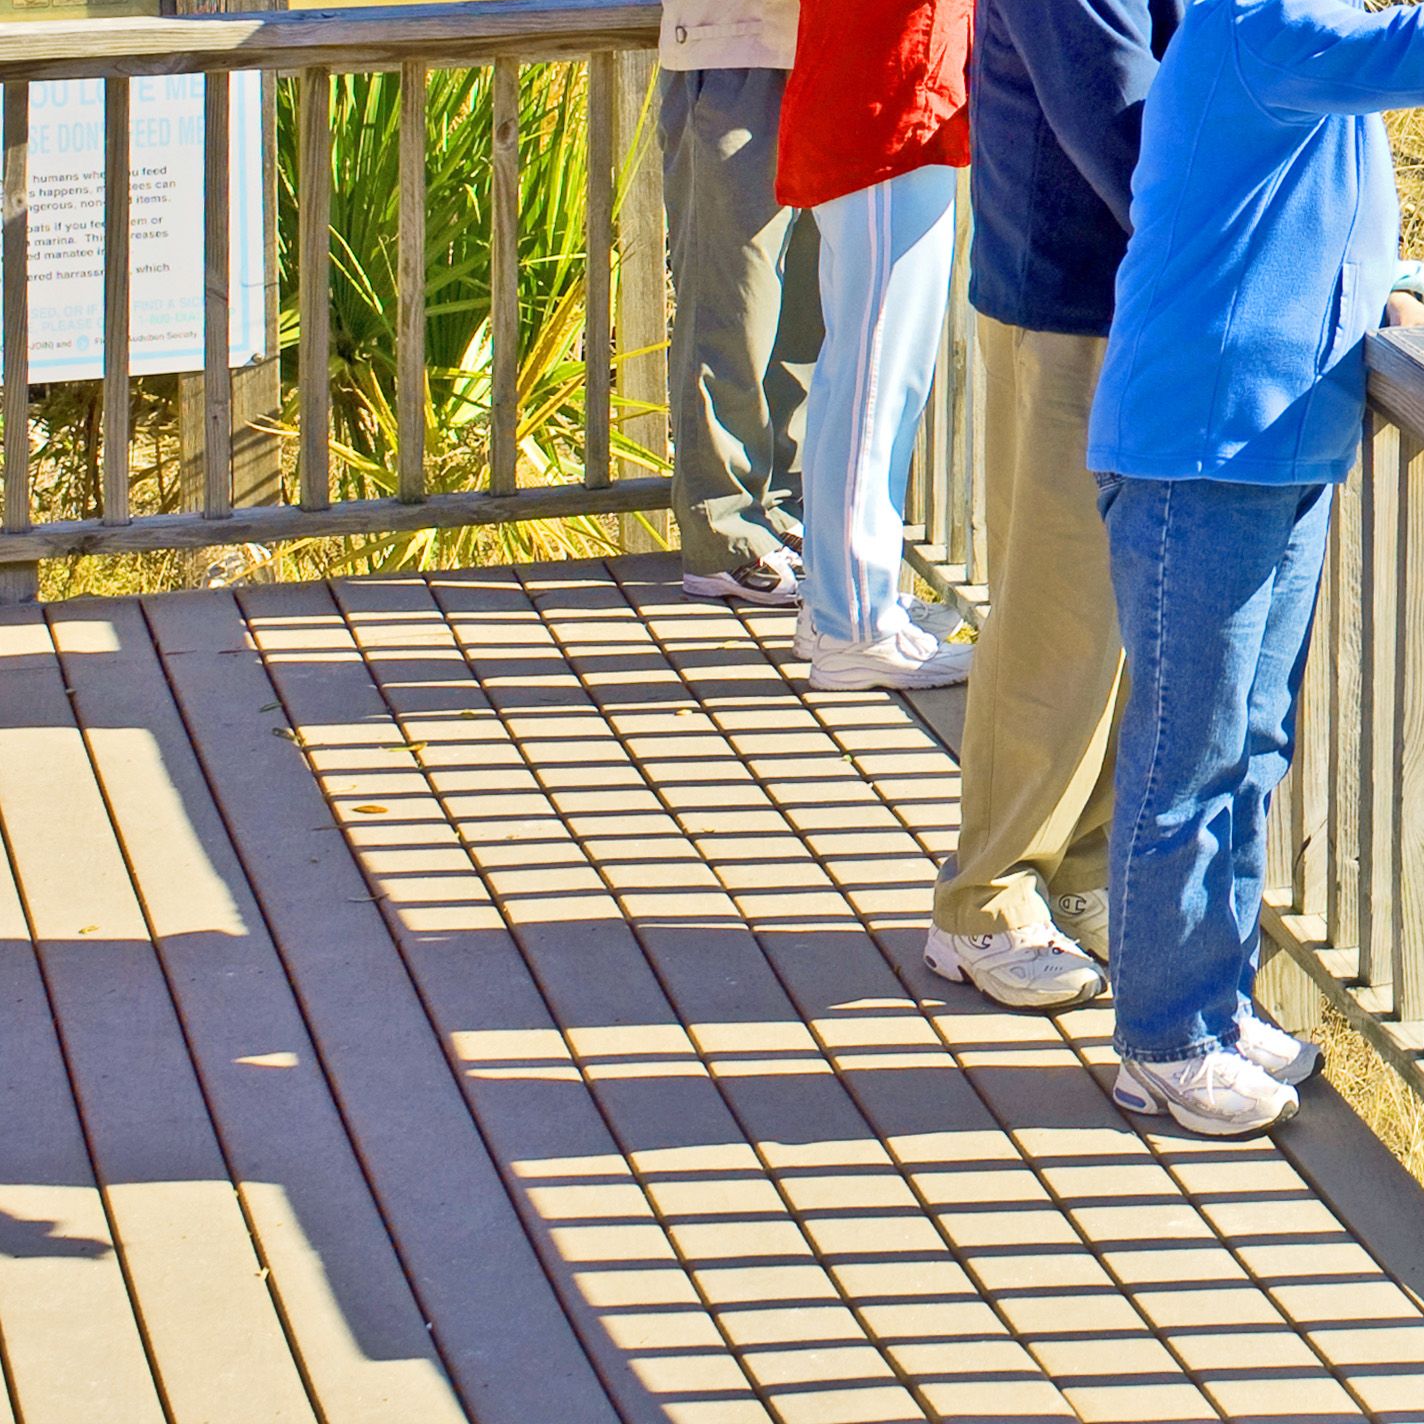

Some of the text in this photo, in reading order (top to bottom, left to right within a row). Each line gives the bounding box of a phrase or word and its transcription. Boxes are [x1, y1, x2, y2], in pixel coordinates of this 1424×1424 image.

[30, 81, 69, 108] OU
[33, 173, 79, 183] humans
[142, 166, 167, 176] feed
[155, 180, 176, 189] can
[54, 221, 62, 231] if
[65, 221, 87, 233] you
[44, 249, 94, 260] manatee
[136, 263, 170, 274] which
